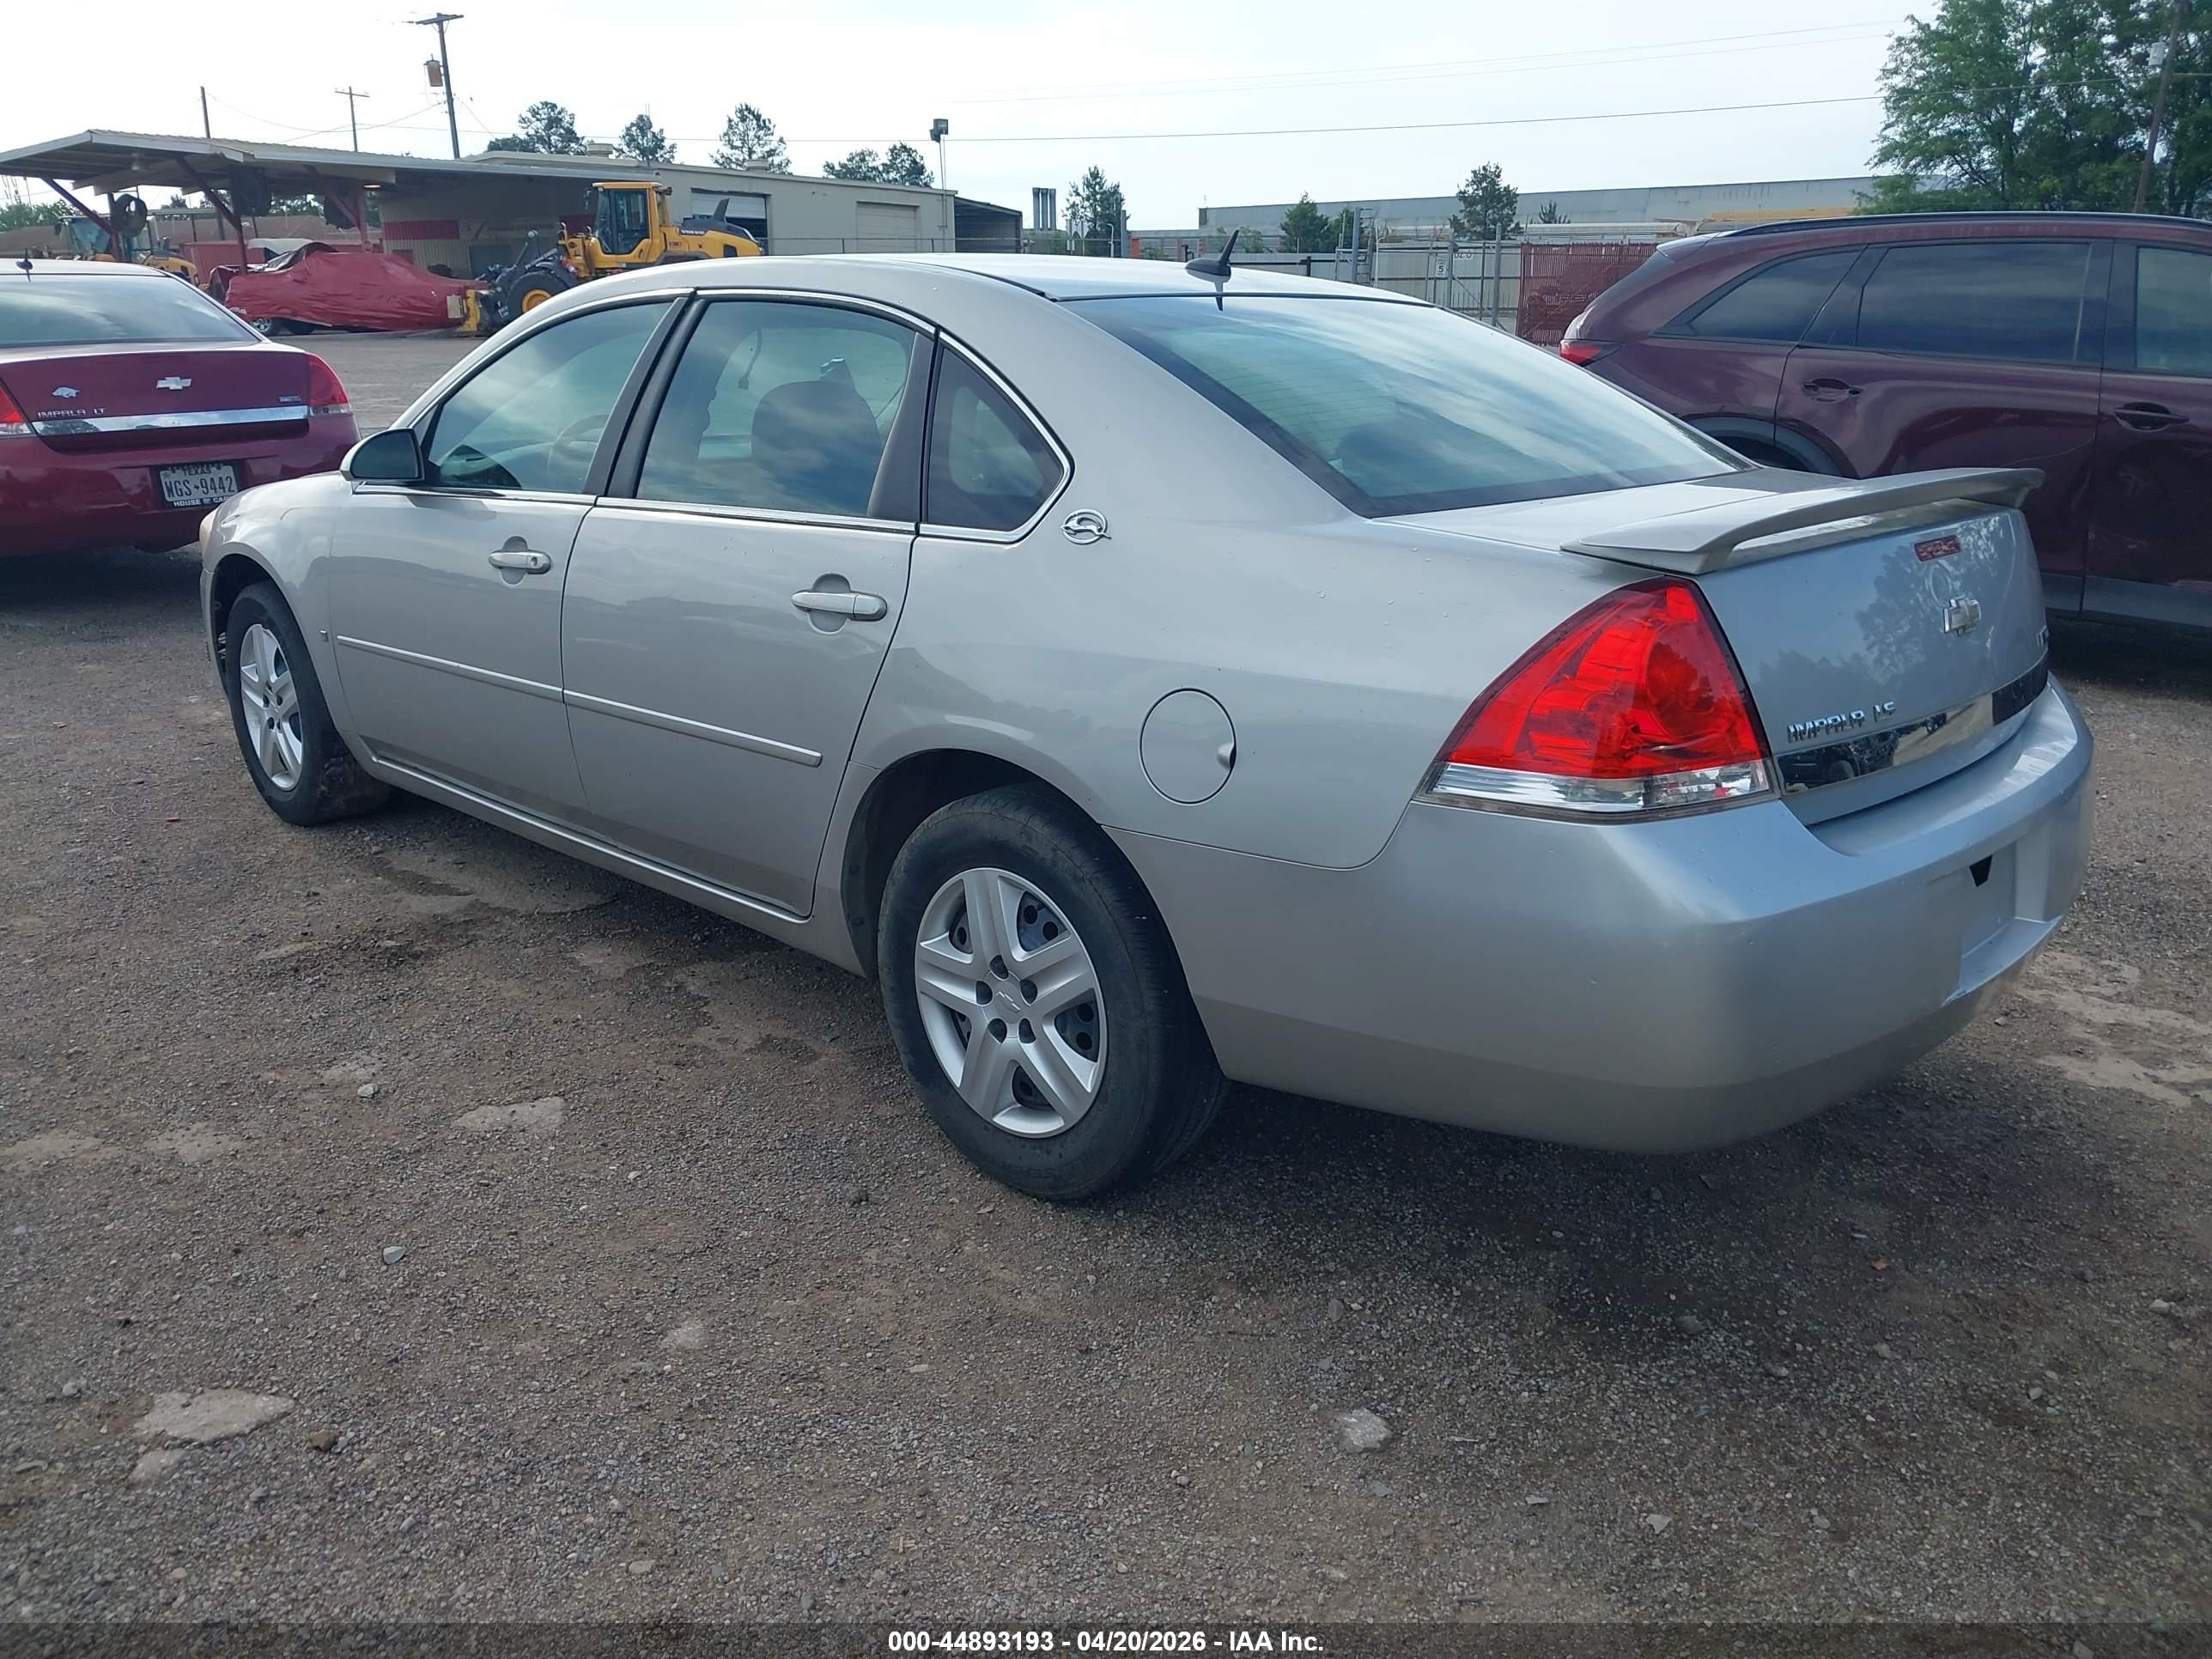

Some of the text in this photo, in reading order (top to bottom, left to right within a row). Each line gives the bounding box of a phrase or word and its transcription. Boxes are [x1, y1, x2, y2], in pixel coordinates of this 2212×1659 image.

[37, 409, 86, 418] IMPALA
[183, 465, 213, 477] TEXAS
[1787, 710, 1865, 744] IMPALA
